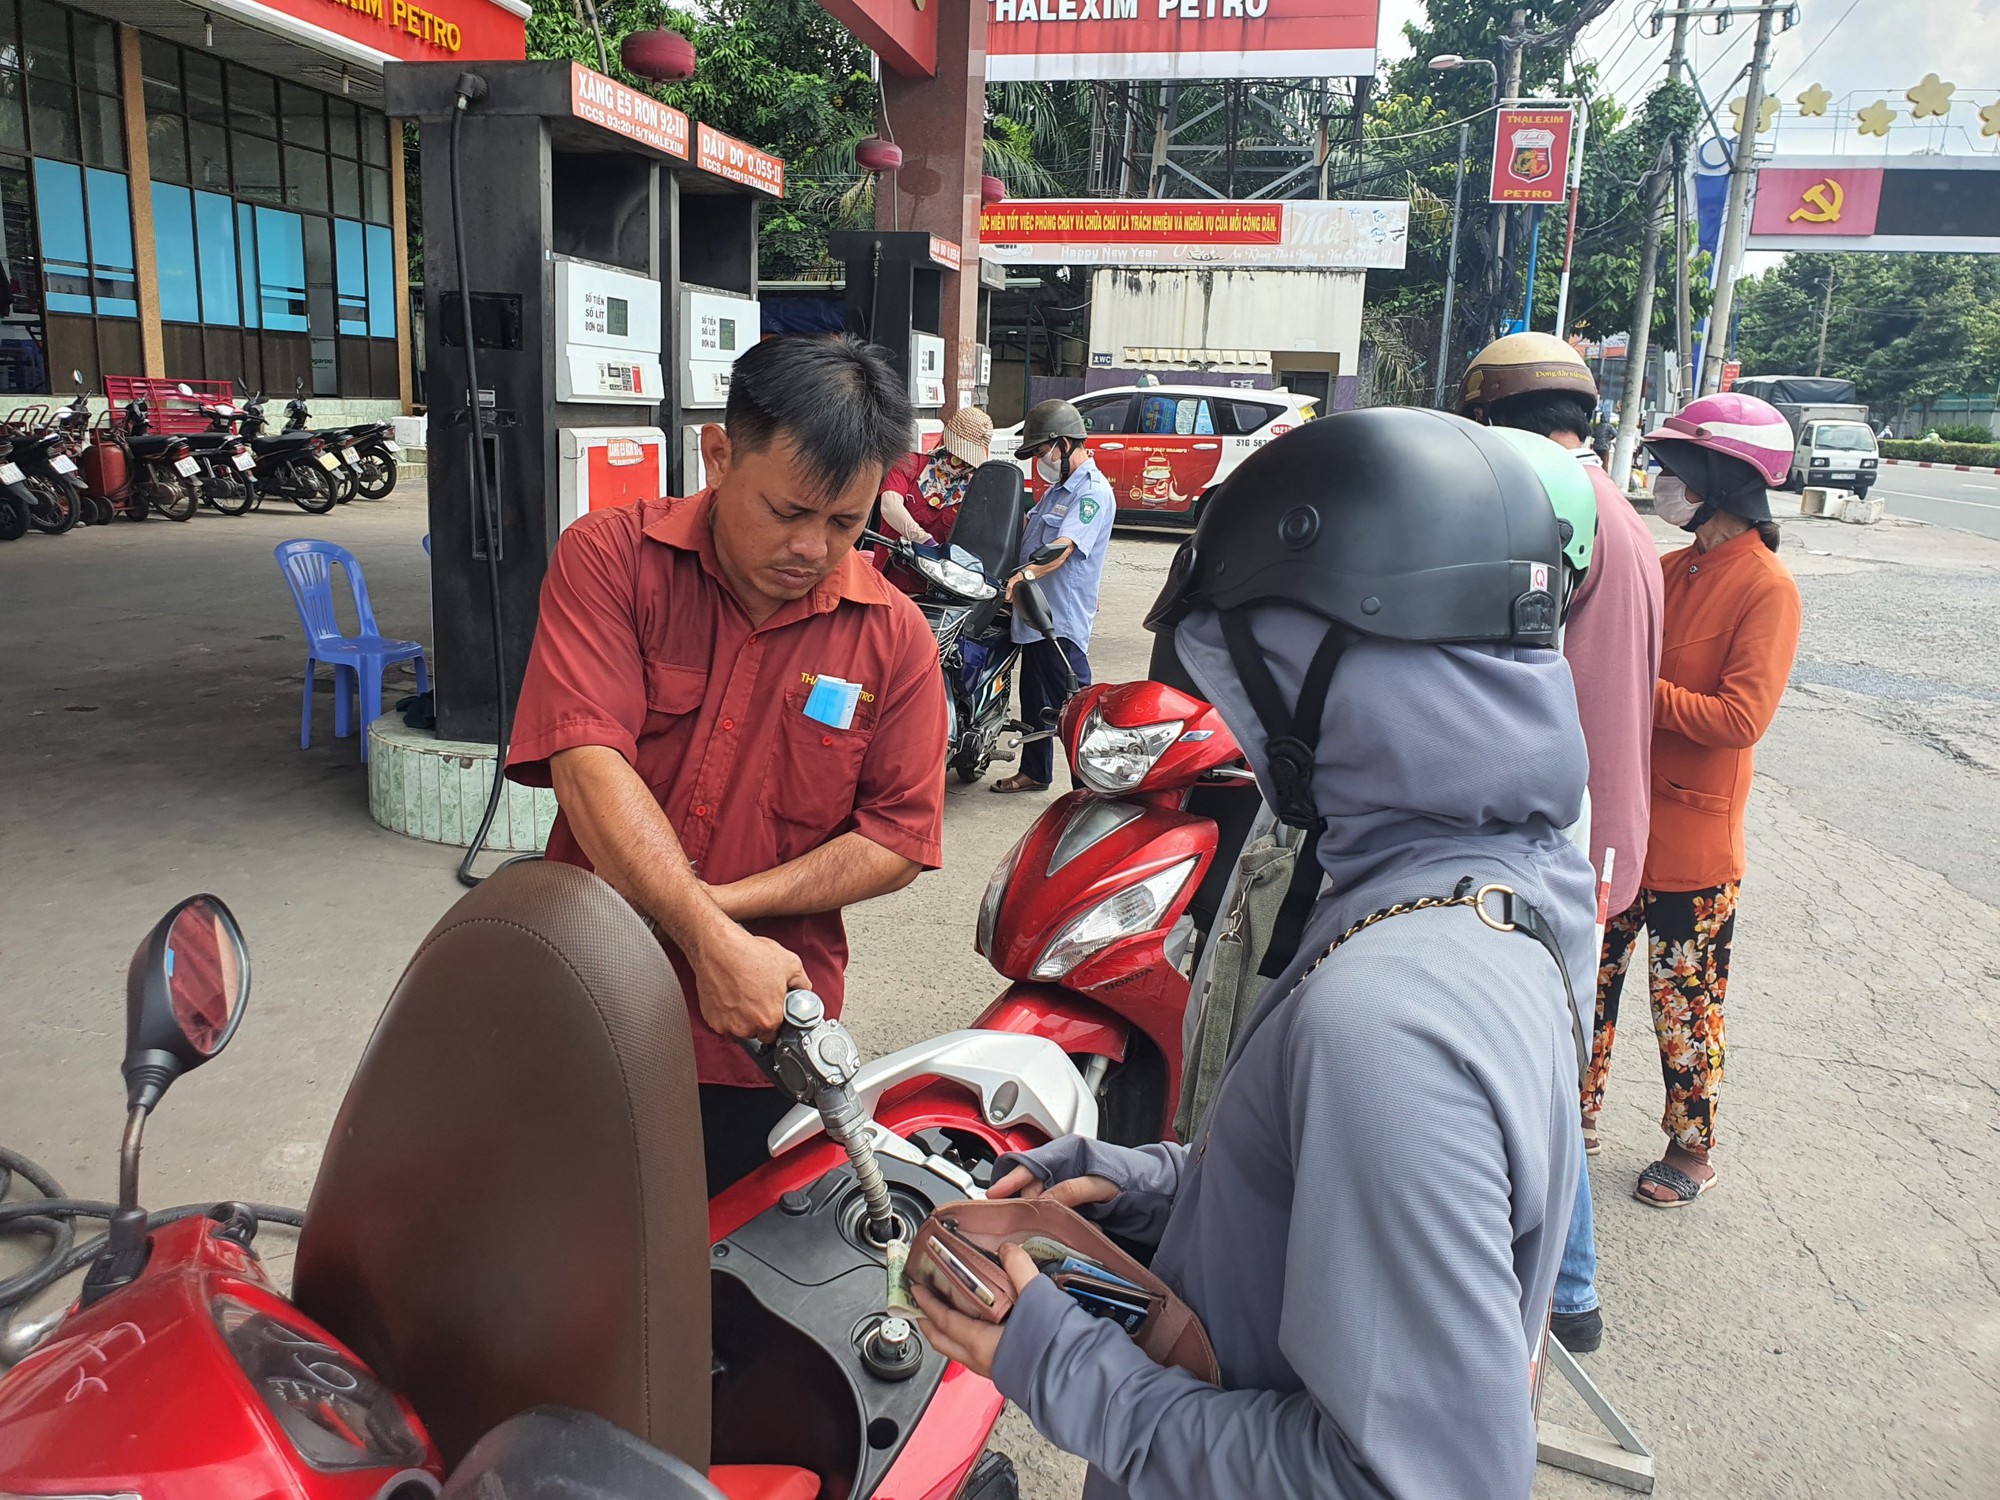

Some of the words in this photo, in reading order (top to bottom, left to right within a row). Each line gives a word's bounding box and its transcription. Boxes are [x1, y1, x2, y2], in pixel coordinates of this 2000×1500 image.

[988, 0, 1137, 21] HALEXIM
[1157, 0, 1268, 19] PETRO
[391, 0, 462, 51] PETRO
[577, 70, 613, 109] XĂNG
[616, 88, 632, 117] E5
[634, 95, 658, 129] RON
[578, 101, 605, 124] TCCS
[1507, 115, 1564, 124] THALEXIM
[701, 156, 722, 174] TCCS
[729, 145, 744, 169] DO
[1503, 189, 1553, 198] PETRO
[1006, 208, 1019, 231] TỐT
[1019, 211, 1035, 236] VIỆC
[1035, 210, 1057, 231] PHÒNG
[1057, 210, 1075, 231] CHÁY
[1075, 210, 1085, 231] VÀ
[1102, 210, 1121, 231] CHÁY
[1121, 210, 1130, 231] LÀ
[1130, 210, 1152, 231] TRÁCH
[1152, 212, 1174, 236] NHIỆM
[1174, 210, 1183, 231] VÀ
[1205, 215, 1215, 236] VỤ
[1215, 209, 1229, 232] CỦA
[1242, 212, 1261, 232] CÔNG
[1061, 247, 1099, 261] Happy
[1103, 247, 1128, 258] New
[1130, 247, 1159, 258] Year
[1099, 355, 1112, 364] WC
[1104, 967, 1154, 992] HONDA
